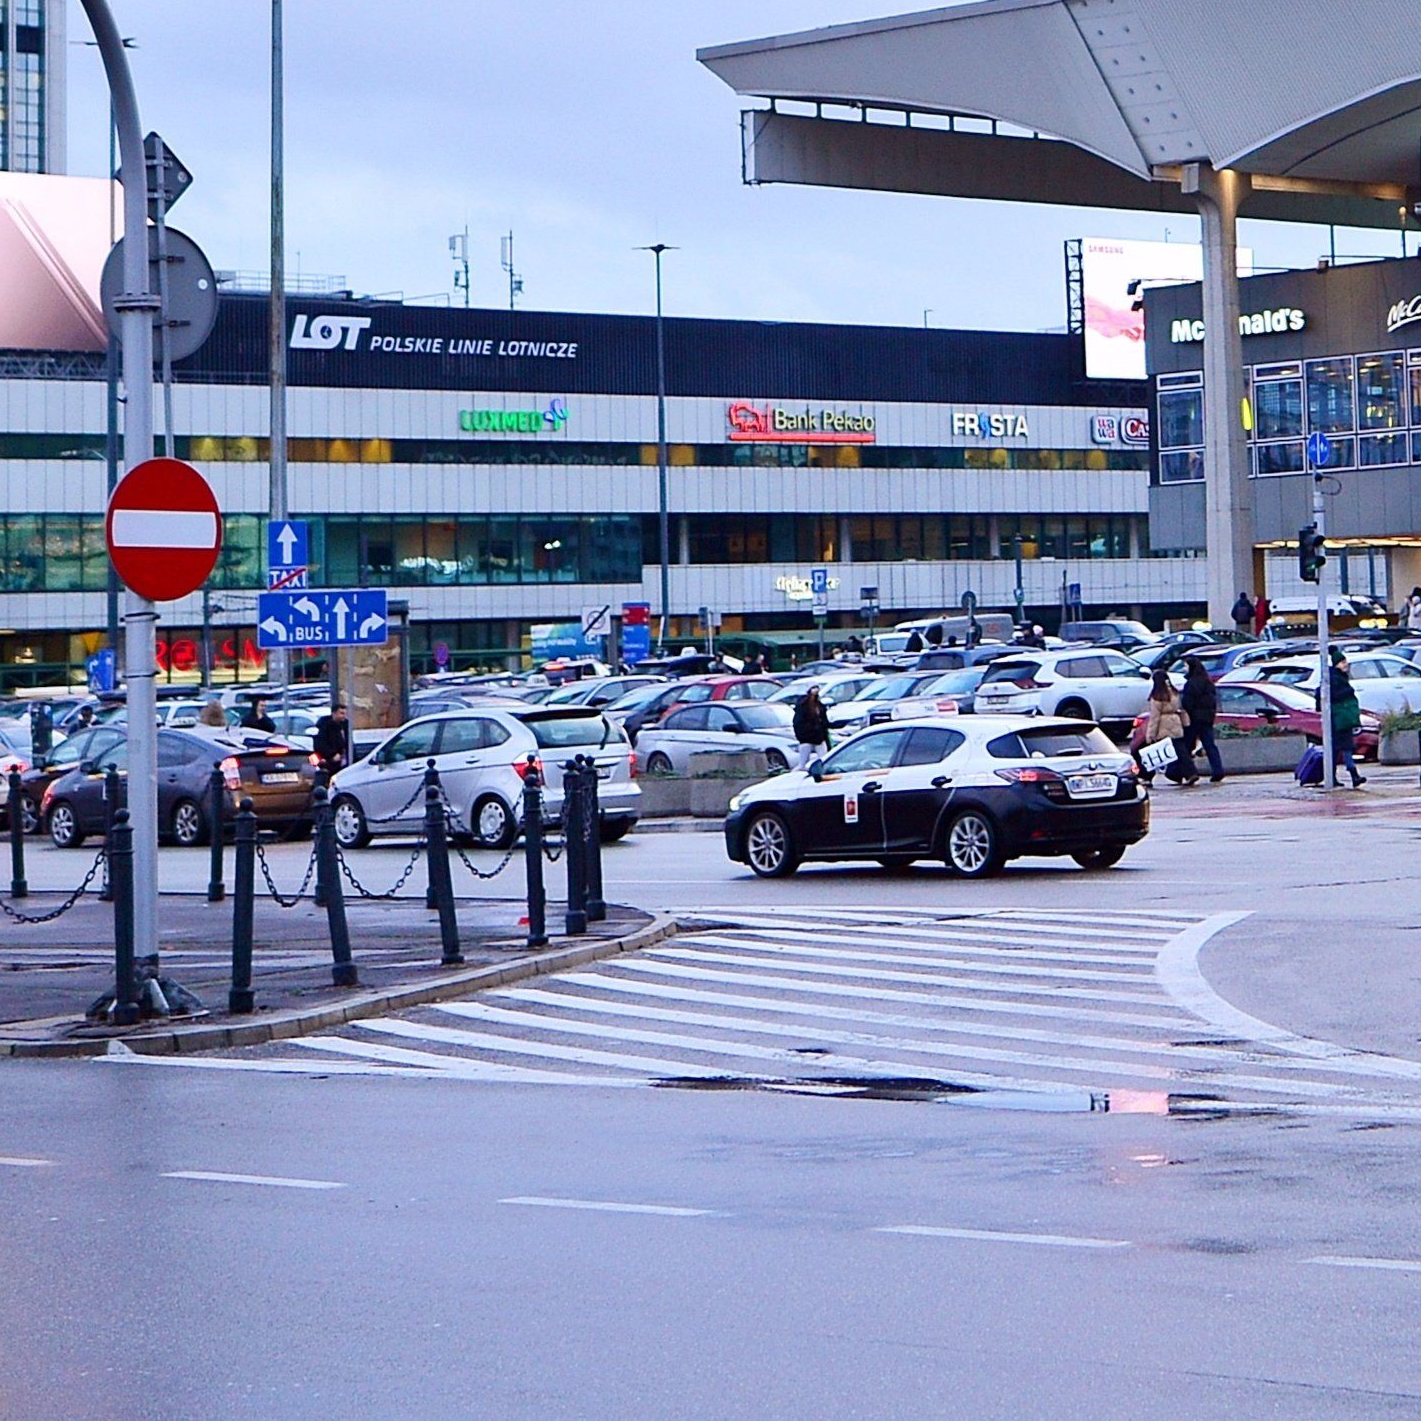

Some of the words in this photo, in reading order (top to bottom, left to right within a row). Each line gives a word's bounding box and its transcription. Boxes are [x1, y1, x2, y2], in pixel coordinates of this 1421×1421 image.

[289, 314, 372, 350] LOT
[370, 336, 443, 354] POLSKIE
[448, 339, 493, 355] LINIE
[498, 341, 578, 358] LOTNICZE
[1171, 308, 1305, 343] Mcnald's
[774, 408, 816, 428] Bank
[822, 410, 875, 431] Pekao
[270, 569, 307, 588] TAXI
[295, 626, 323, 640] BUS
